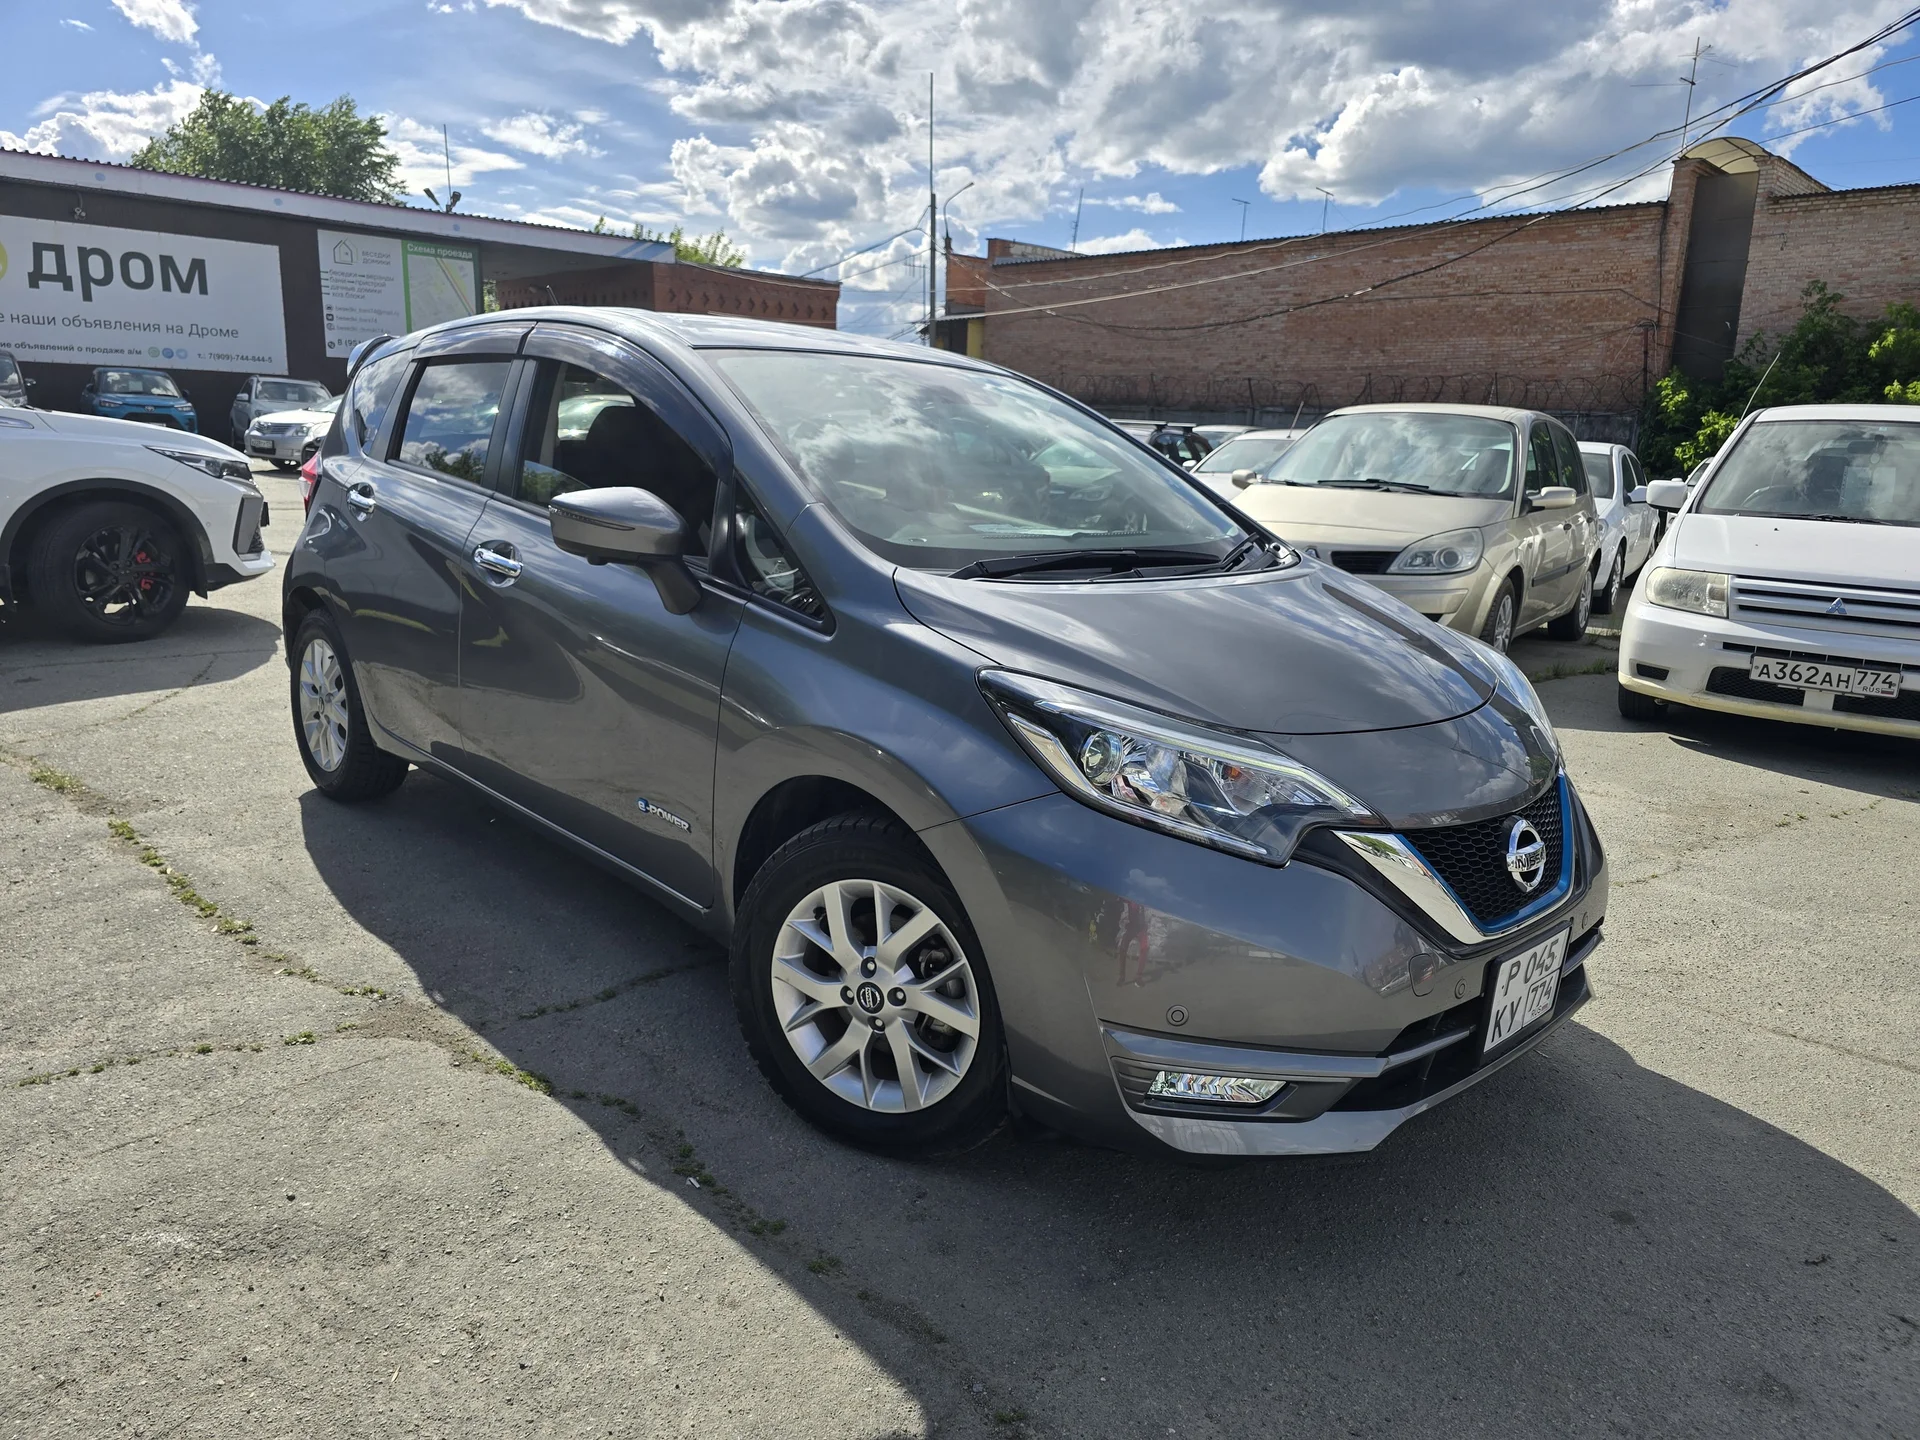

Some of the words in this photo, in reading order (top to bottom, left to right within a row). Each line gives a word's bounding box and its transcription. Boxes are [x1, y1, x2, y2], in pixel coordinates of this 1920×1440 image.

[407, 243, 436, 254] Схема
[437, 247, 473, 259] проезда
[27, 241, 209, 302] дром
[10, 313, 57, 326] наши
[61, 315, 161, 334] объявления
[166, 323, 184, 335] на
[188, 323, 239, 339] Дроме
[14, 341, 75, 353] объявлений
[77, 345, 83, 353] о
[85, 346, 125, 356] продаже
[1857, 671, 1893, 689] 774
[1862, 685, 1881, 694] RUS
[1524, 938, 1559, 985] 045
[1527, 976, 1553, 1013] 774
